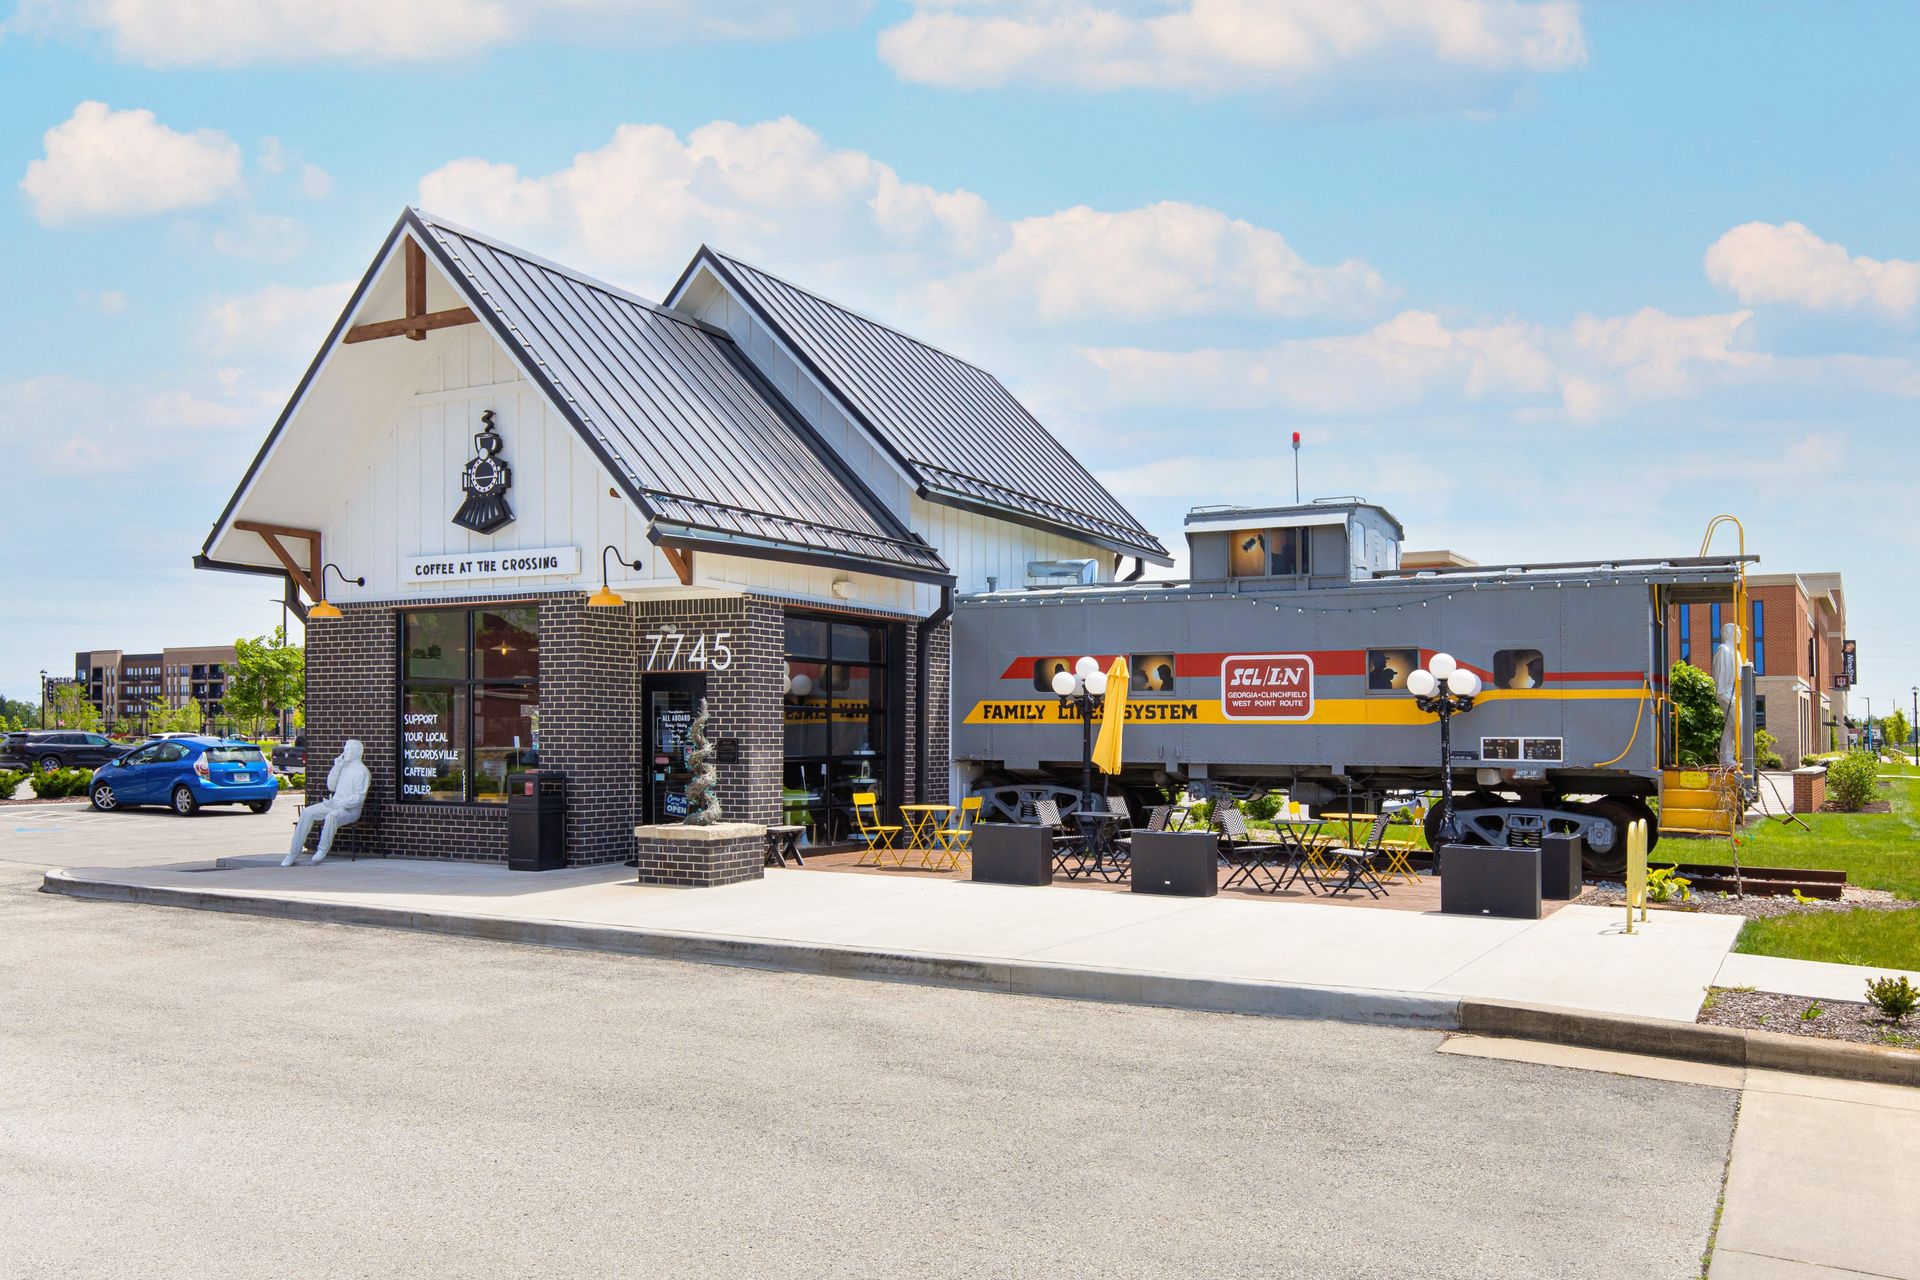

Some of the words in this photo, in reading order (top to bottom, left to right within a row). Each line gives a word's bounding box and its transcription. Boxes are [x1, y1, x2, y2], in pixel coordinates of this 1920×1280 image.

[415, 563, 454, 575] COFFEE
[459, 561, 472, 574] AT
[477, 560, 496, 572] THE
[502, 556, 558, 571] CROSSING
[645, 633, 731, 671] 7745
[983, 704, 1046, 719] FAMILY
[1124, 704, 1197, 719] SYSTEM
[404, 714, 438, 725] SUPPORT
[404, 732, 423, 742] YOUR
[425, 732, 448, 742] LOCAL
[404, 749, 459, 760] MCCORDSVILLE
[404, 767, 437, 777] CAFFEINE
[403, 784, 433, 795] DEALER.
[666, 804, 687, 814] OPEN
